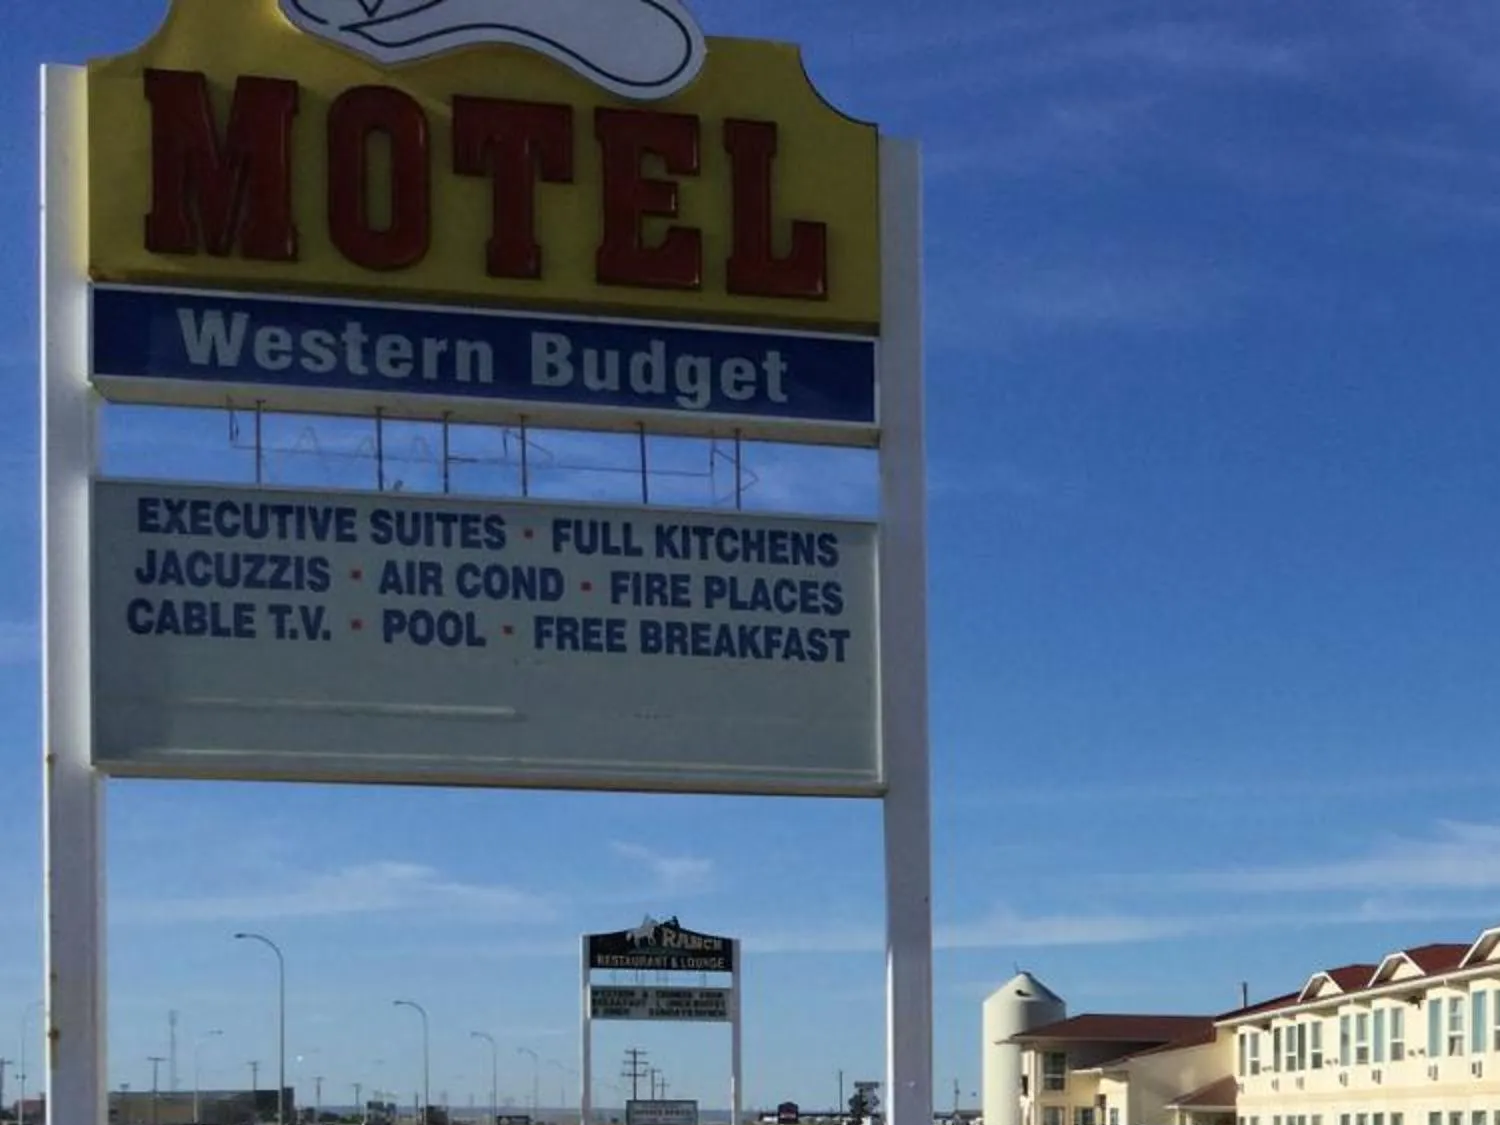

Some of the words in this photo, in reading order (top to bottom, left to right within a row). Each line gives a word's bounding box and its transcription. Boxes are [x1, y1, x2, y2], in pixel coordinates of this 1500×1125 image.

[144, 70, 826, 298] MOTEL
[178, 309, 493, 386] Western
[530, 331, 789, 411] Budget
[137, 497, 357, 544] EXECUTIVE
[369, 507, 507, 550] SUITES
[552, 518, 643, 558] FULL
[655, 523, 839, 567] KITCHENS
[135, 549, 331, 593] JACUZZIS
[378, 560, 443, 597] AIR
[457, 563, 564, 602] COND
[611, 571, 691, 609] FIRE
[704, 575, 844, 616] PLACES
[126, 599, 256, 639] CABLE
[269, 604, 331, 641] T.V.
[382, 609, 486, 648] POOL
[534, 615, 627, 653] FREE
[640, 620, 850, 663] BREAKFAST
[662, 928, 722, 951] RANCH
